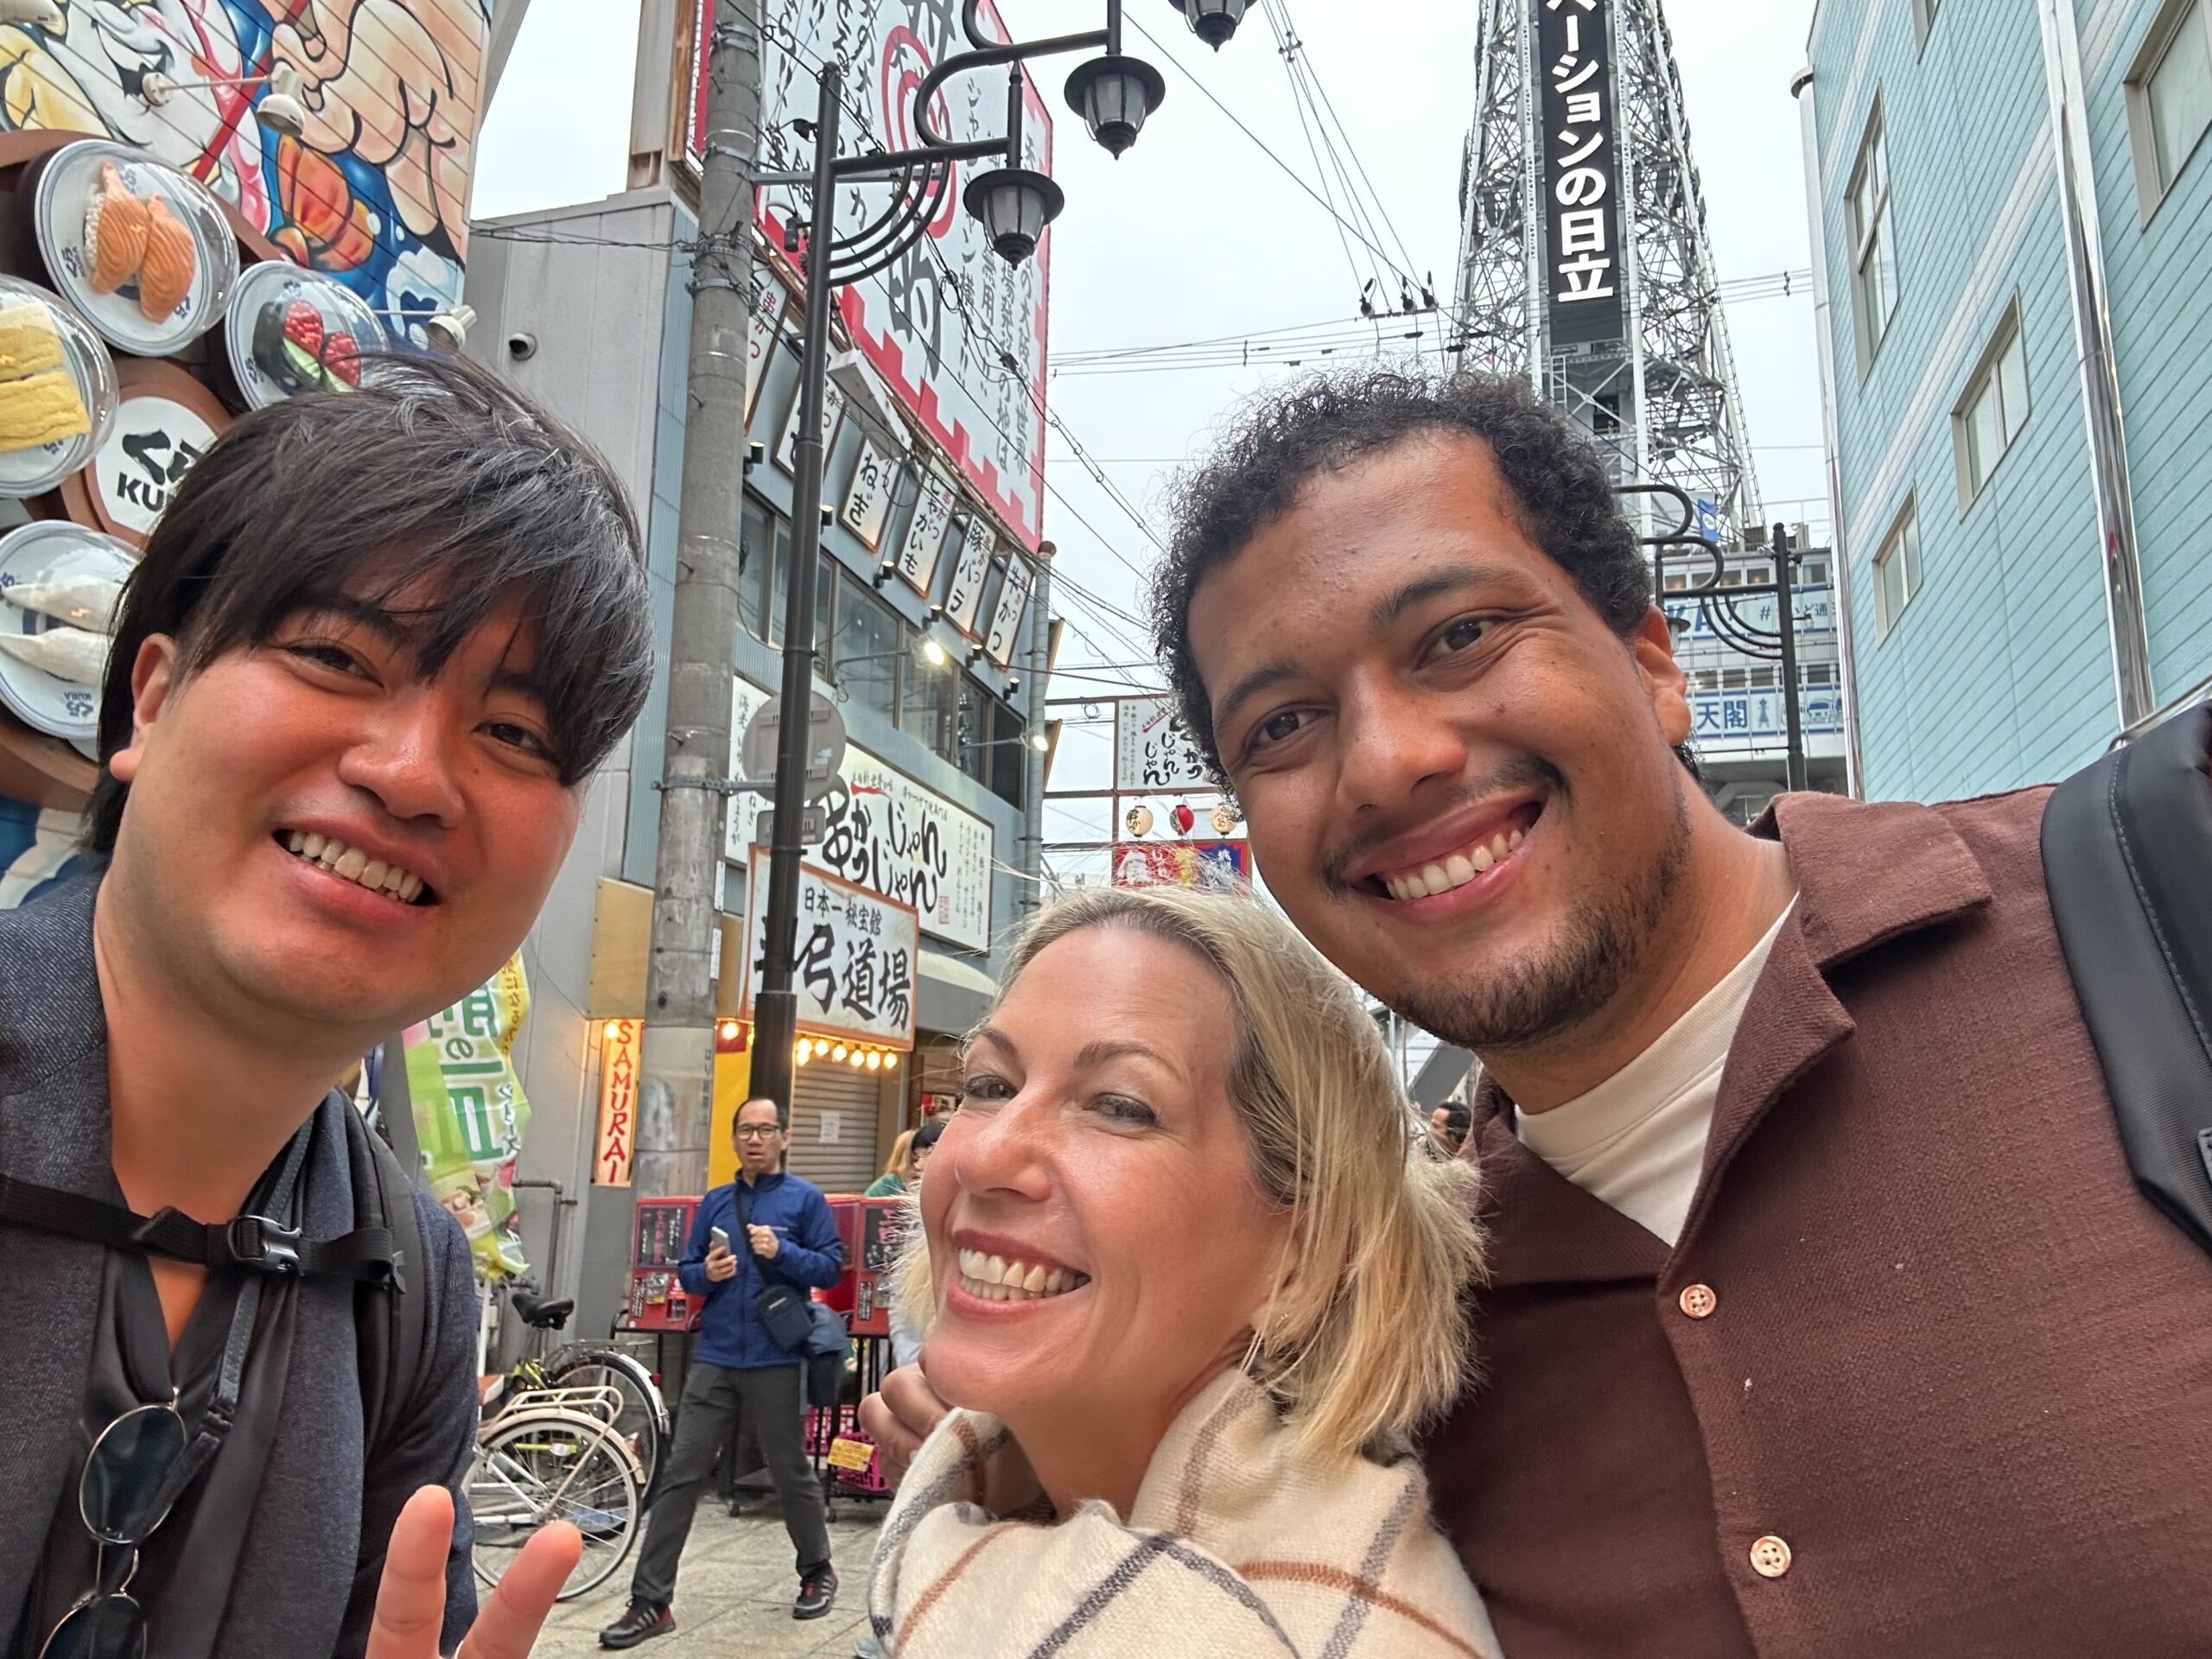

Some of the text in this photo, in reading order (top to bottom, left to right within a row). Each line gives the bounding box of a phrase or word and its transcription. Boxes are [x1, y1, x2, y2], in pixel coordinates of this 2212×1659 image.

[117, 471, 175, 512] KU
[849, 453, 879, 527] ねぎ
[905, 472, 941, 576] じゃがいも
[804, 886, 882, 937] 日本一秘宝館
[754, 916, 911, 1031] 弓道場
[602, 1019, 634, 1185] SAMURAI
